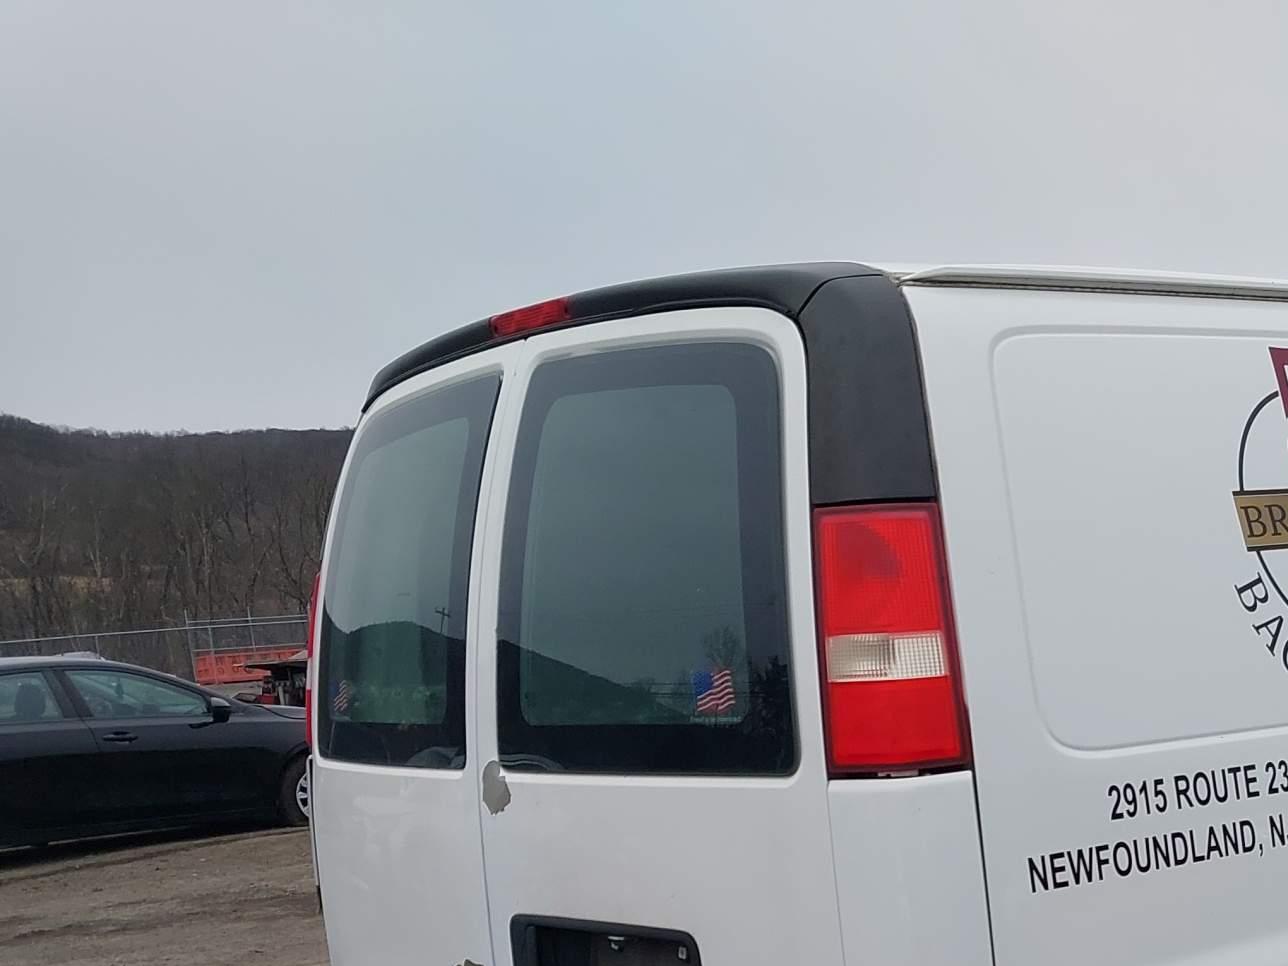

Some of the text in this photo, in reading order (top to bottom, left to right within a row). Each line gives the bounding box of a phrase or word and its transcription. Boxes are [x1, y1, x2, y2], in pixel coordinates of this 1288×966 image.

[1107, 778, 1168, 821] 2915
[1173, 764, 1260, 810] ROUTE
[1027, 819, 1264, 894] NEWFOUNDLAND,
